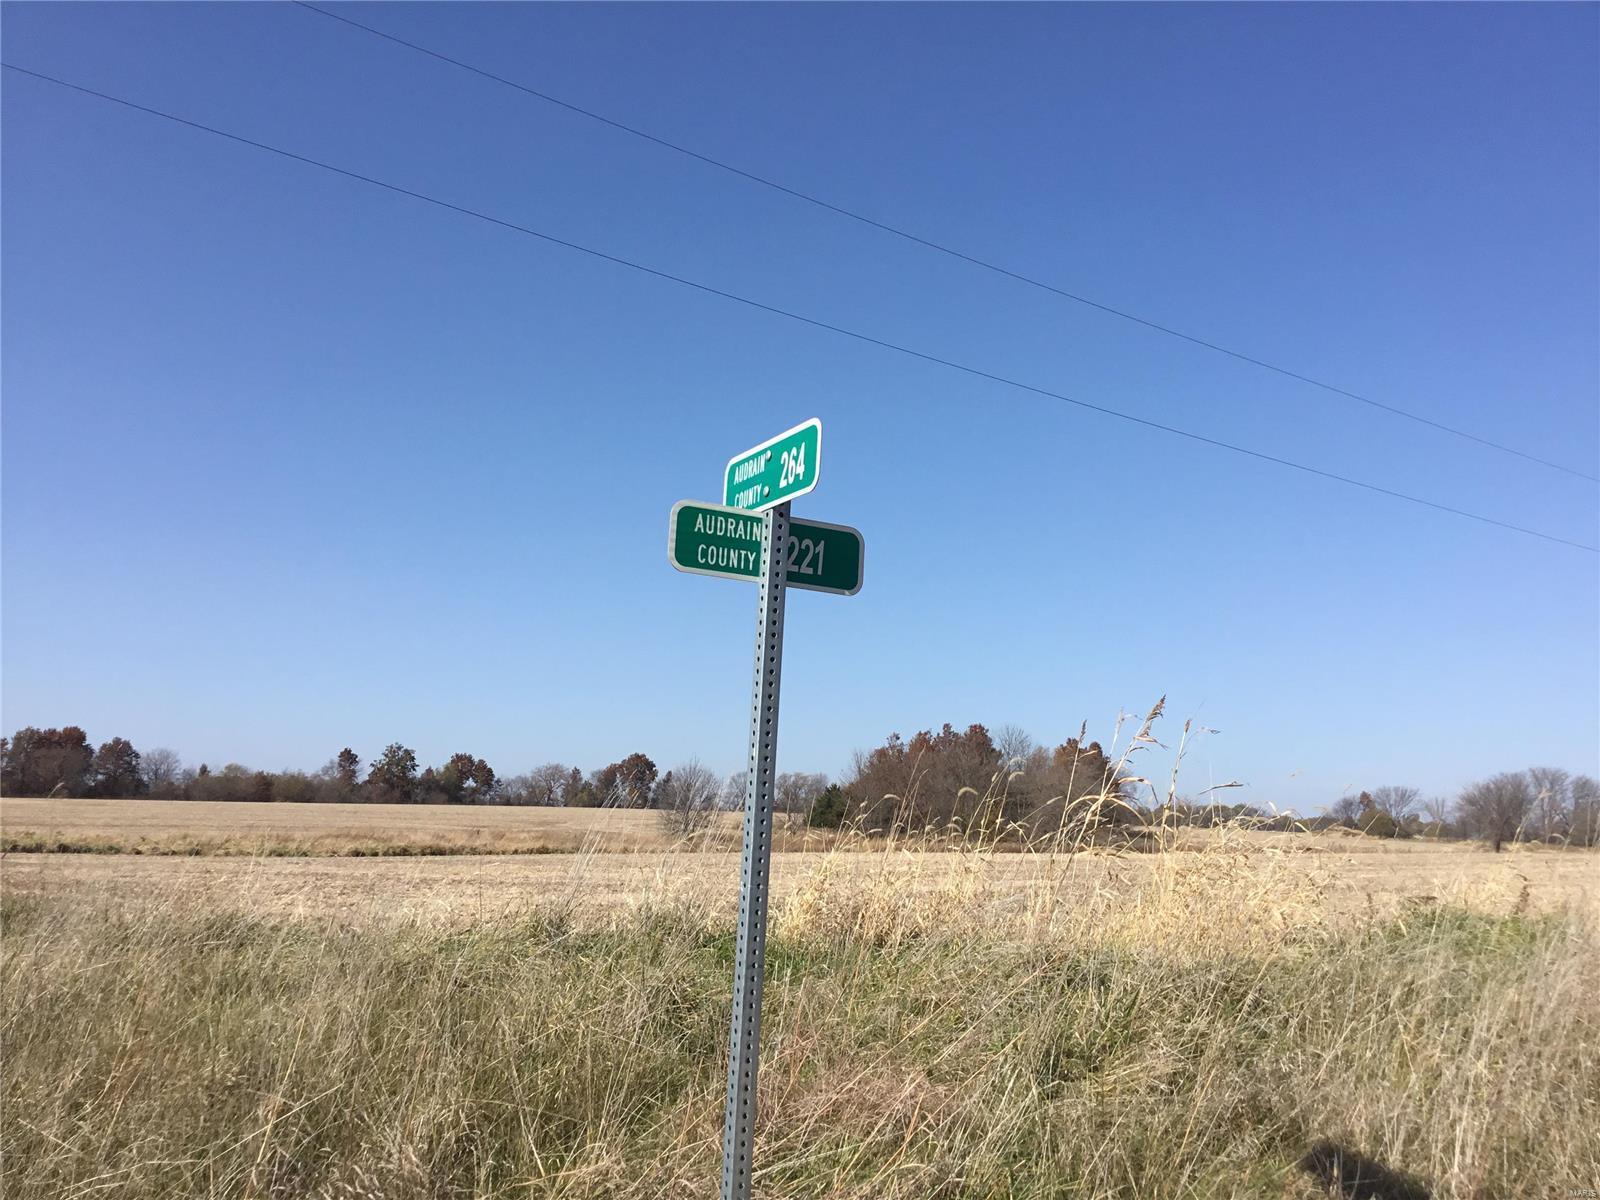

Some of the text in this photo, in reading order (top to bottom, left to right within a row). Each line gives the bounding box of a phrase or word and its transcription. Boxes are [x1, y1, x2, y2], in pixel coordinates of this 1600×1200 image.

[734, 453, 766, 485] AUDRAIN
[779, 441, 805, 488] 264
[734, 483, 762, 509] COUNTY
[694, 513, 761, 542] AUDRAIN
[697, 544, 756, 571] COUNTY
[786, 535, 825, 576] 221
